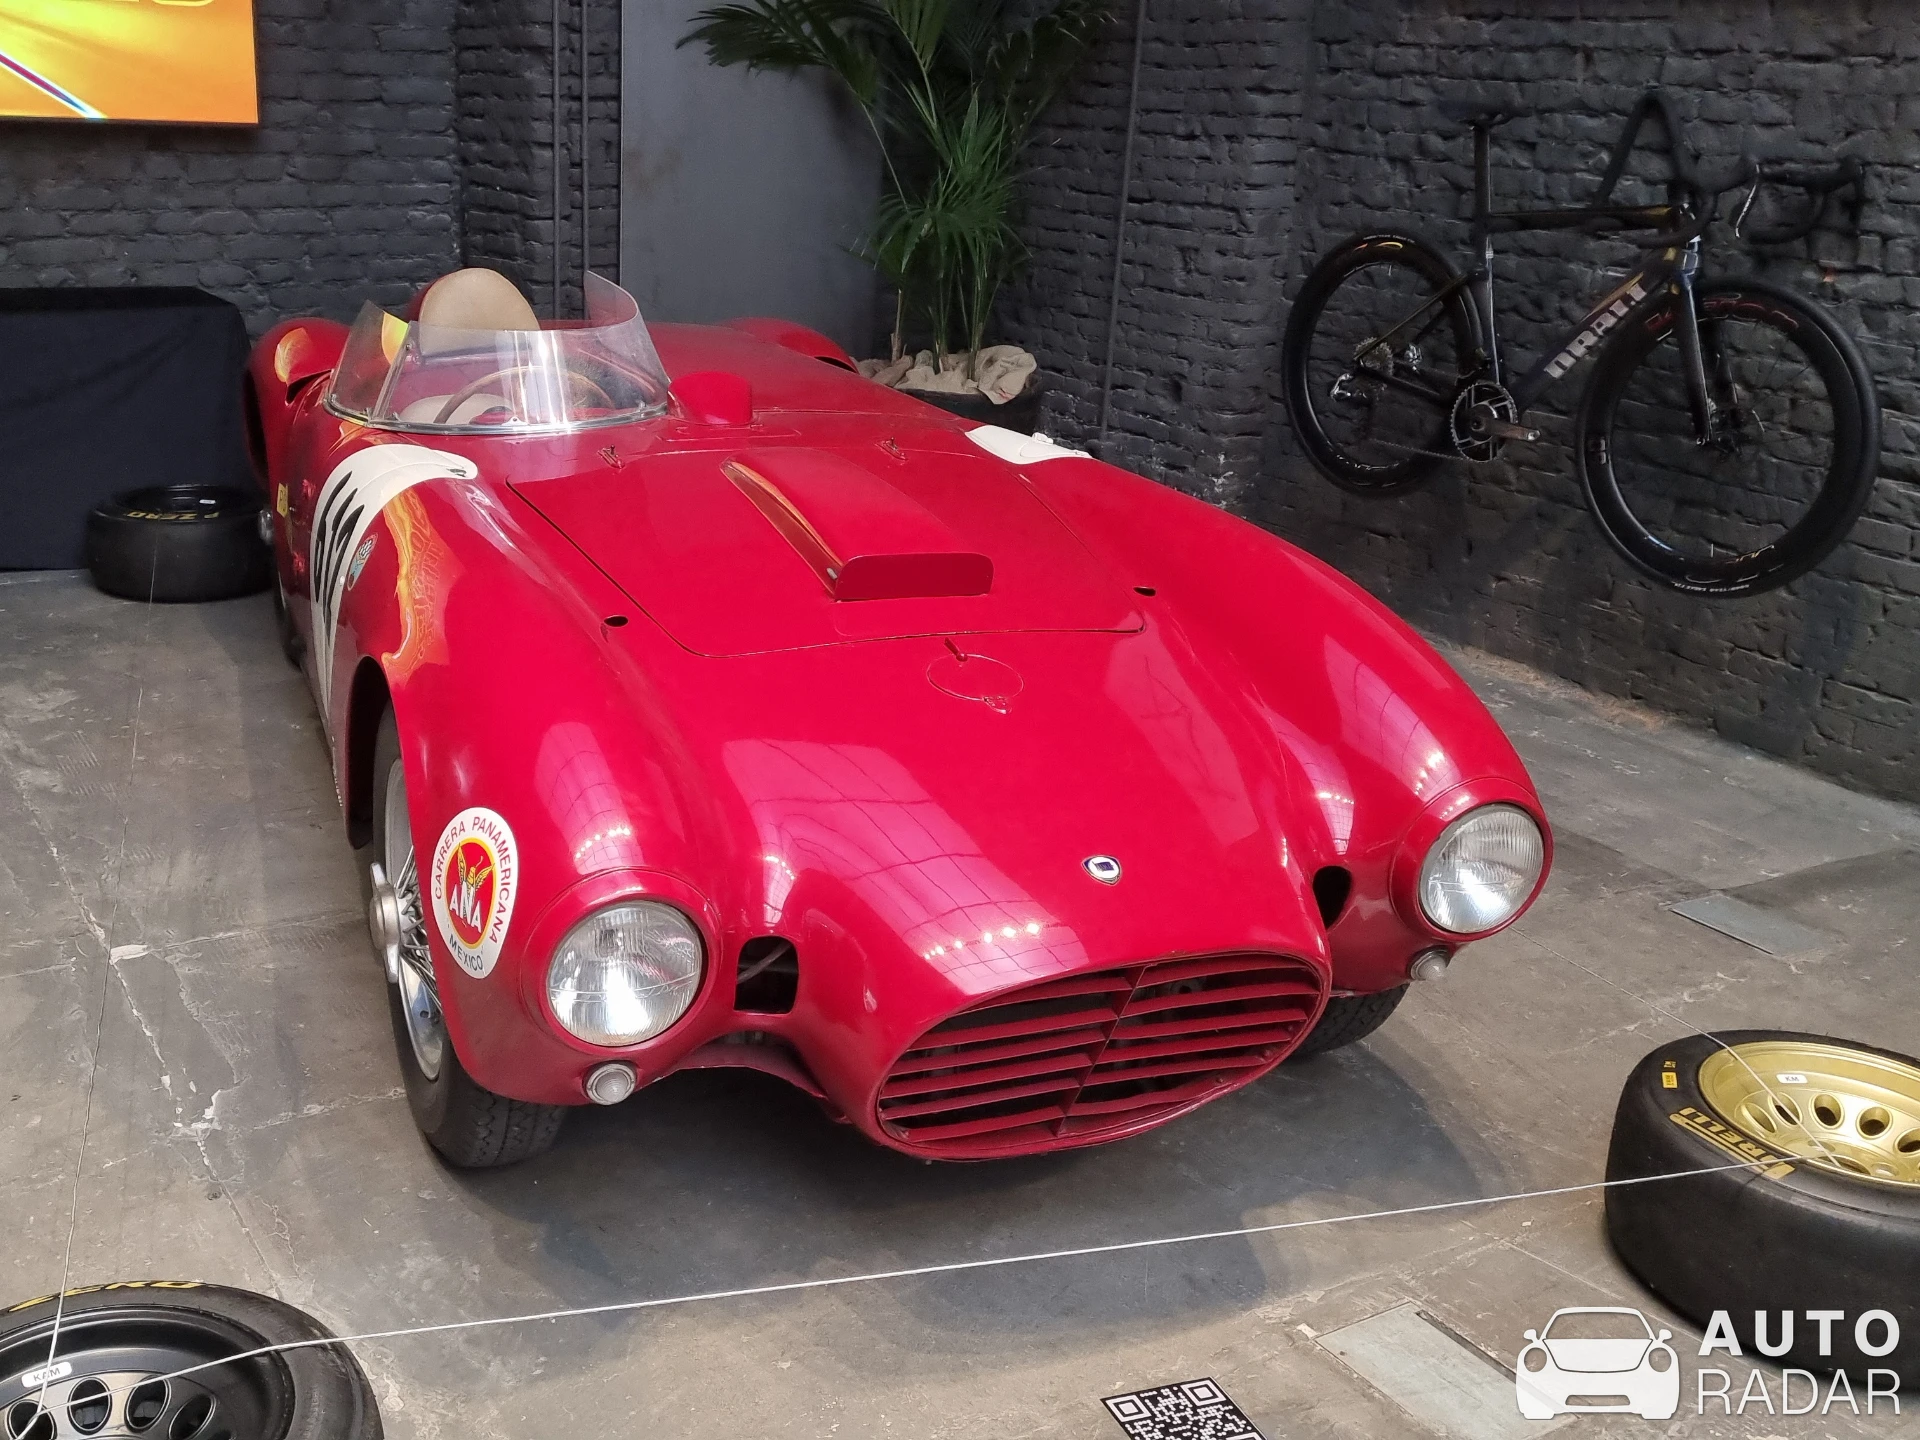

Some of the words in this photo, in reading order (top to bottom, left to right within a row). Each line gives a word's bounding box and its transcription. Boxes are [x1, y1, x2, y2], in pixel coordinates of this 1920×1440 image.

[435, 820, 466, 900] CARRERA
[471, 816, 512, 944] PANAMERICANA
[449, 880, 482, 934] ANA
[449, 933, 484, 971] MEXICO
[1669, 1107, 1797, 1180] PIRELLI
